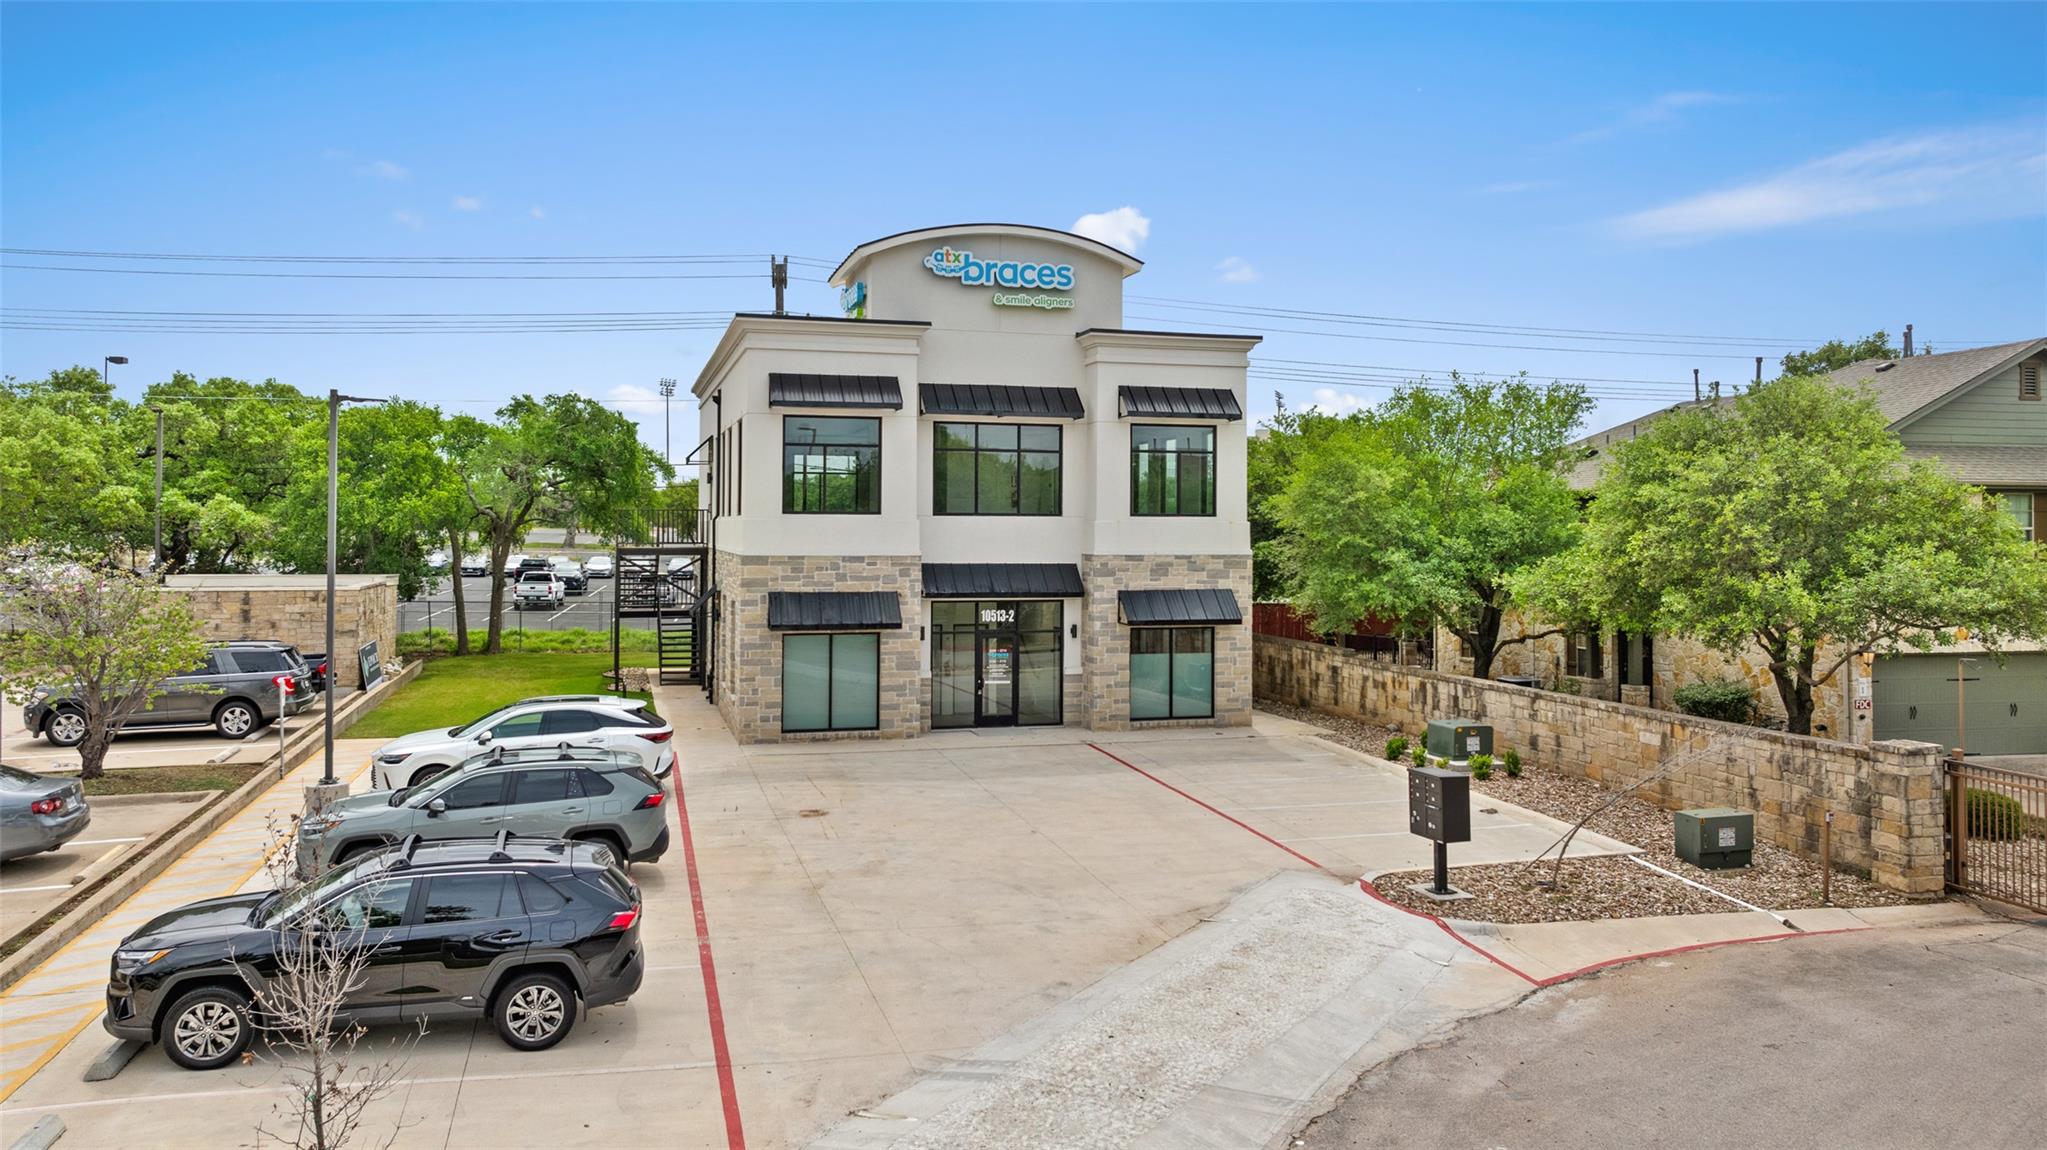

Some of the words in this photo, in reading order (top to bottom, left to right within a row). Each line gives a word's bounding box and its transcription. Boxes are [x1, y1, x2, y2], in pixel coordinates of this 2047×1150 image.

[934, 249, 961, 263] atx
[964, 254, 1073, 287] braces
[995, 294, 1002, 303] &
[1006, 294, 1031, 305] smile
[1034, 295, 1073, 307] aligners
[981, 609, 1014, 622] 10513-2
[1855, 700, 1870, 709] FDC
